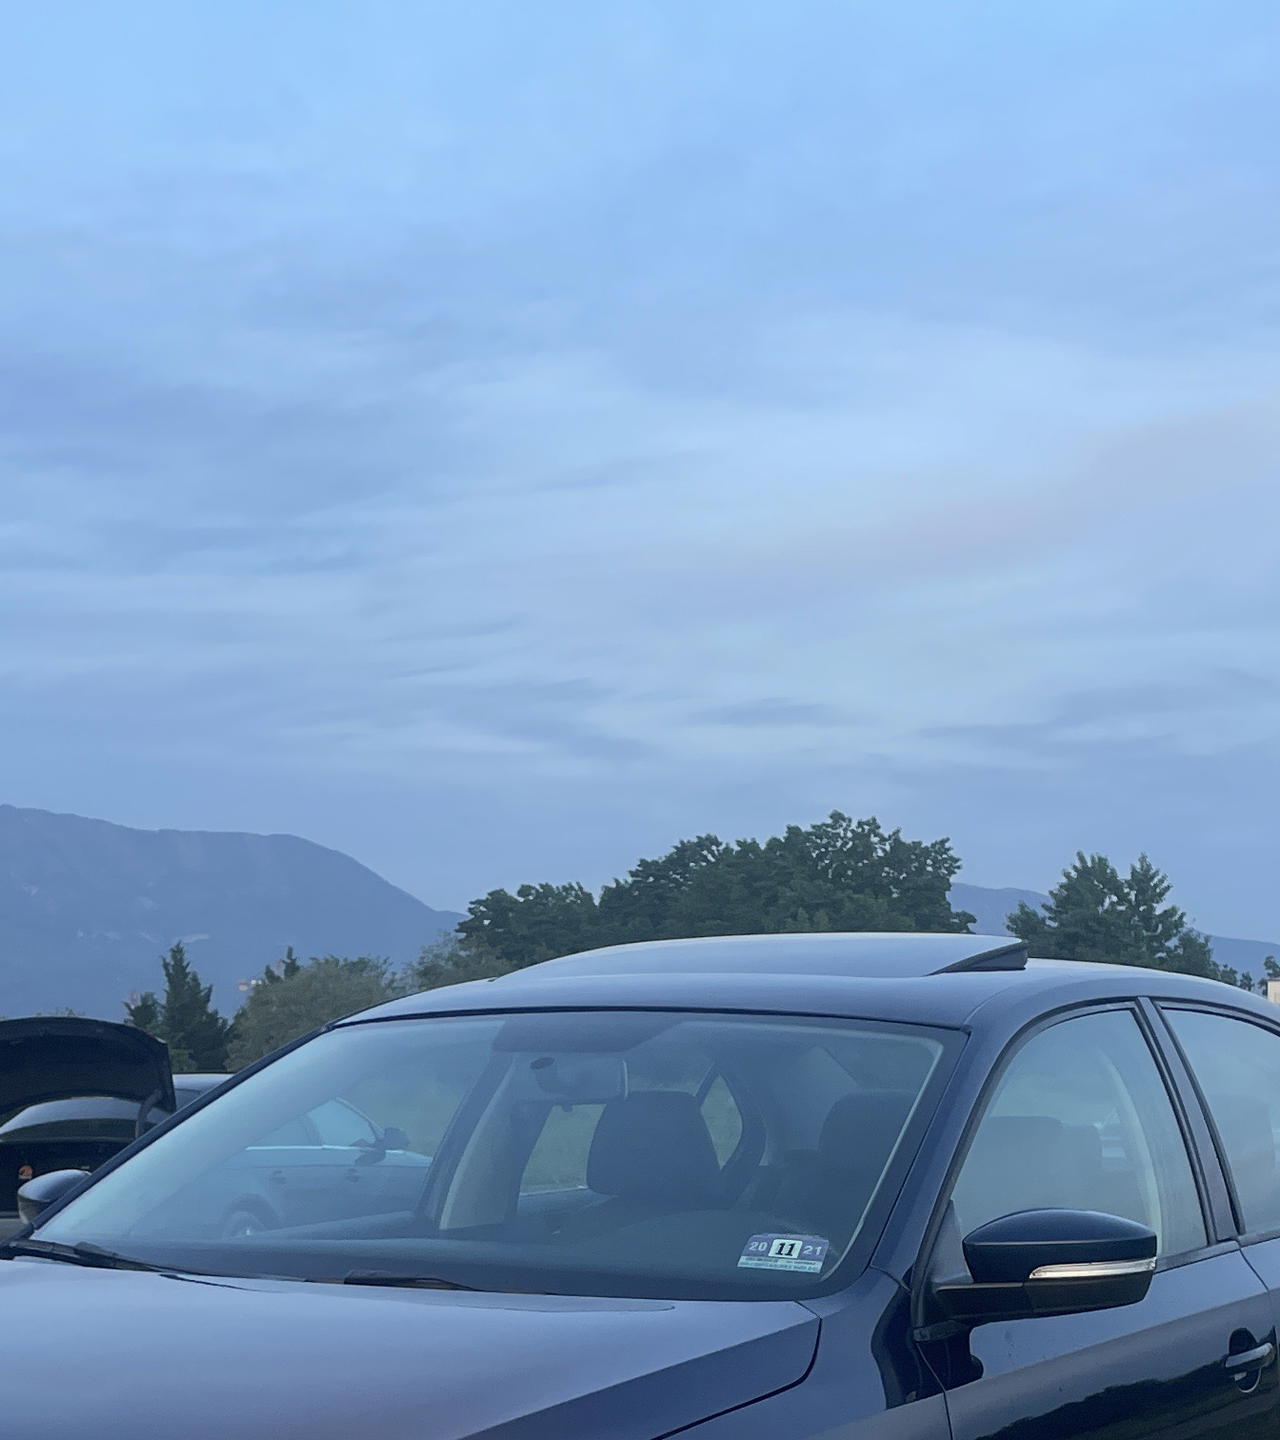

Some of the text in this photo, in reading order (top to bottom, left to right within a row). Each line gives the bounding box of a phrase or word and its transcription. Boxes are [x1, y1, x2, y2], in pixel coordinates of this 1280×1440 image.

[749, 1241, 822, 1257] 20 11 21
